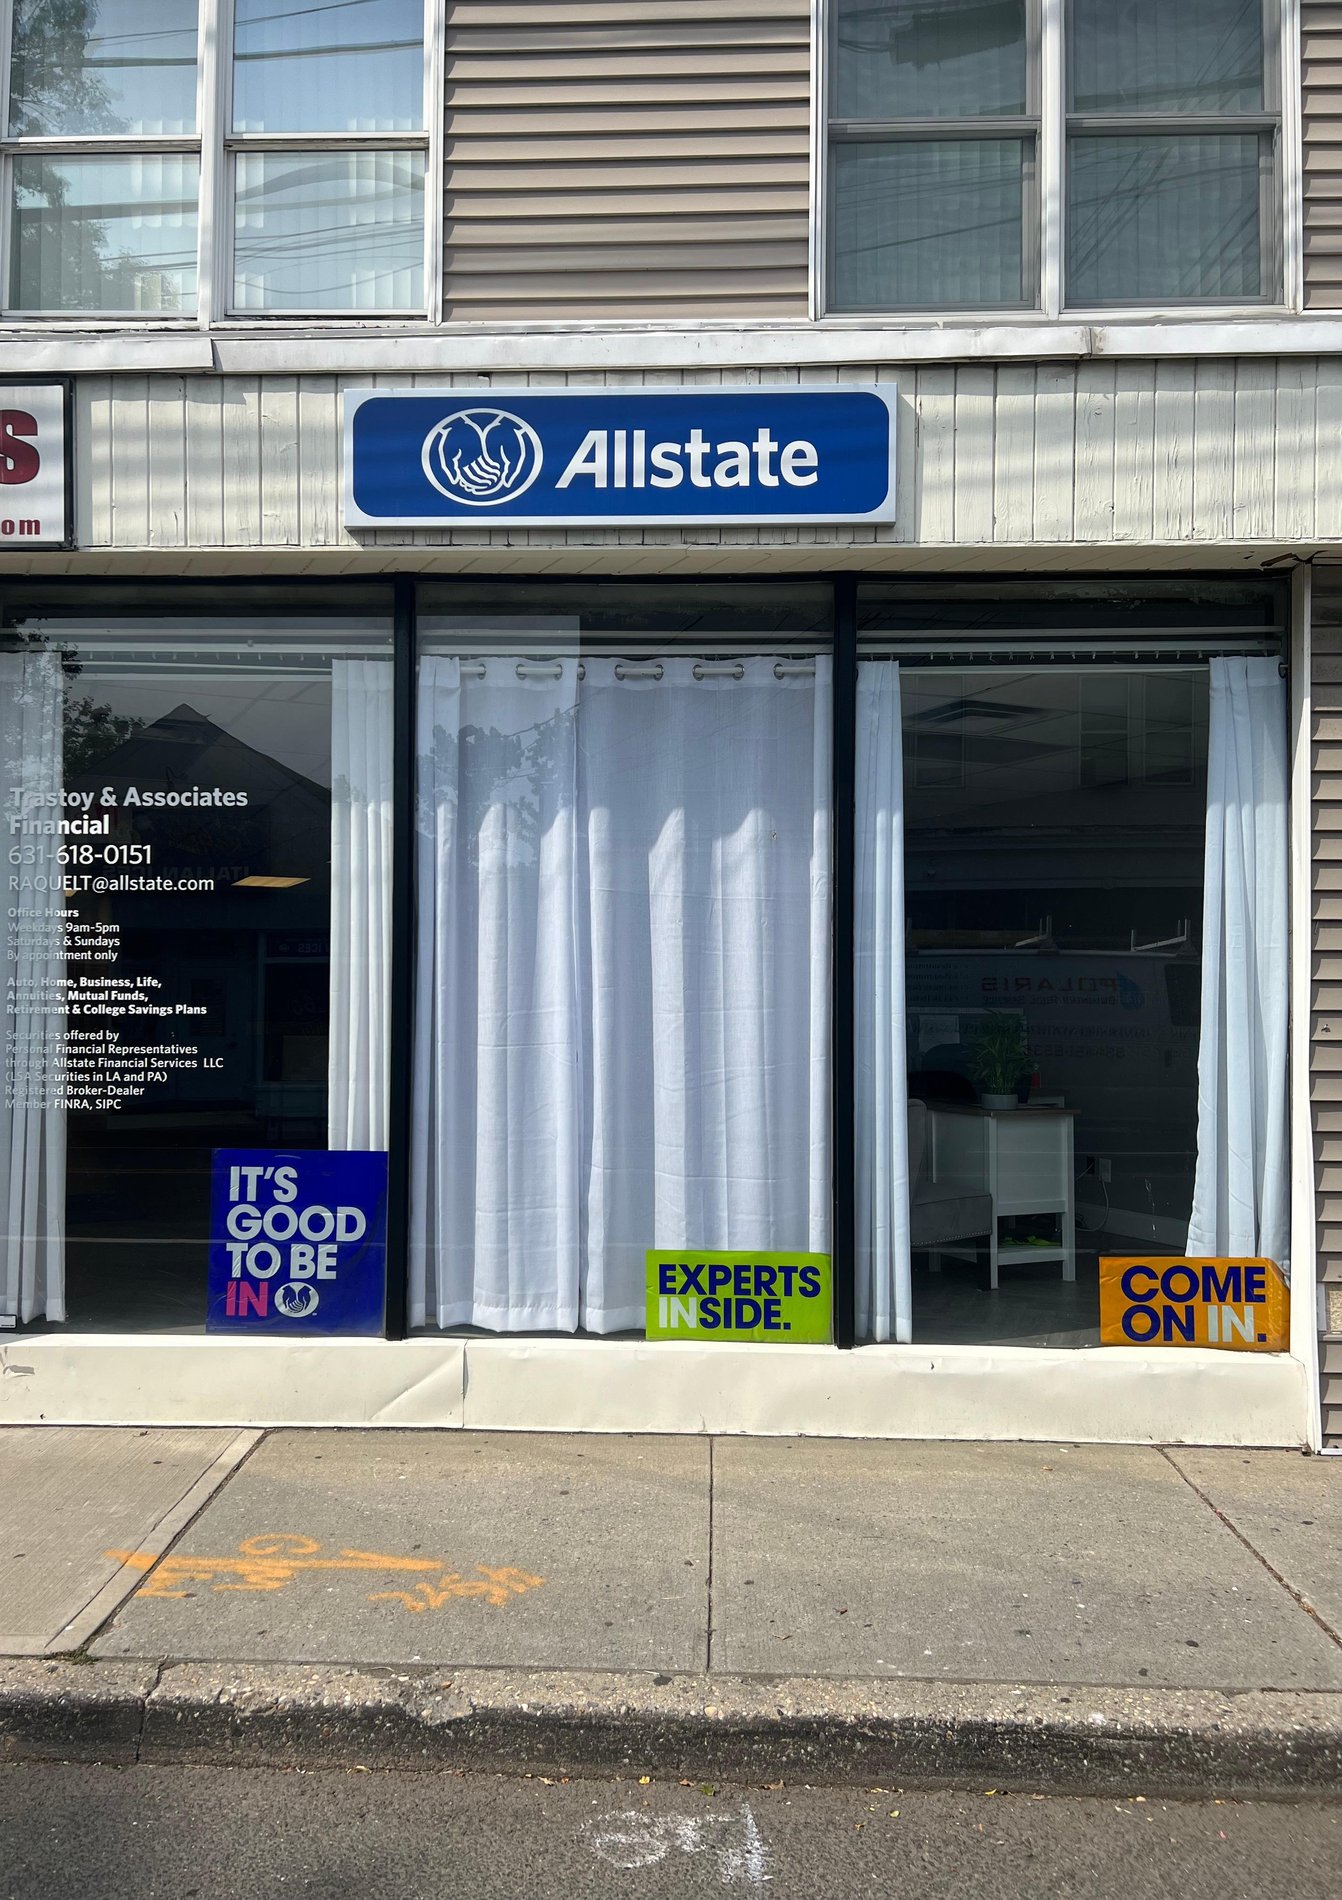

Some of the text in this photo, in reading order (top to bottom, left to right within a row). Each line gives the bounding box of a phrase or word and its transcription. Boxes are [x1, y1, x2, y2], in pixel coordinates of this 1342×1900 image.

[554, 426, 819, 490] Allstate
[9, 786, 249, 811] Trastoy & Associates
[9, 814, 110, 835] Financial
[8, 844, 152, 865] 631-618-0151
[8, 874, 215, 894] RAQUELT@allstate.com
[7, 908, 80, 918] Office Hours
[7, 922, 120, 935] Weekdays 9am-5pm
[7, 936, 121, 949] Saturdays & Sundays
[7, 949, 119, 962] By appointment only
[7, 976, 162, 989] Auto, Home, Business, Life,
[7, 990, 149, 1003] Annuities, Mutual Funds,
[6, 1004, 208, 1017] Retirement & College Savings Plans
[6, 1030, 120, 1043] Securities offered by
[5, 1044, 199, 1057] Personal Financial Representatives
[5, 1057, 225, 1070] through Allstate Financial Services LLC
[35, 1071, 91, 1082] Securities
[92, 1071, 104, 1082] in
[105, 1071, 122, 1082] LA
[123, 1071, 145, 1082] and
[147, 1071, 168, 1083] PA)
[5, 1085, 145, 1097] Registered Broker-Dealer
[4, 1098, 122, 1111] Member FINRA, SIPC
[229, 1166, 299, 1203] IT'S
[226, 1203, 367, 1242] GOOD
[226, 1242, 338, 1280] TO BE
[658, 1264, 821, 1298] EXPERTS
[1121, 1265, 1266, 1303] COME
[225, 1281, 269, 1317] IN
[658, 1297, 791, 1330] INSIDE.
[1121, 1304, 1267, 1343] ON IN.
